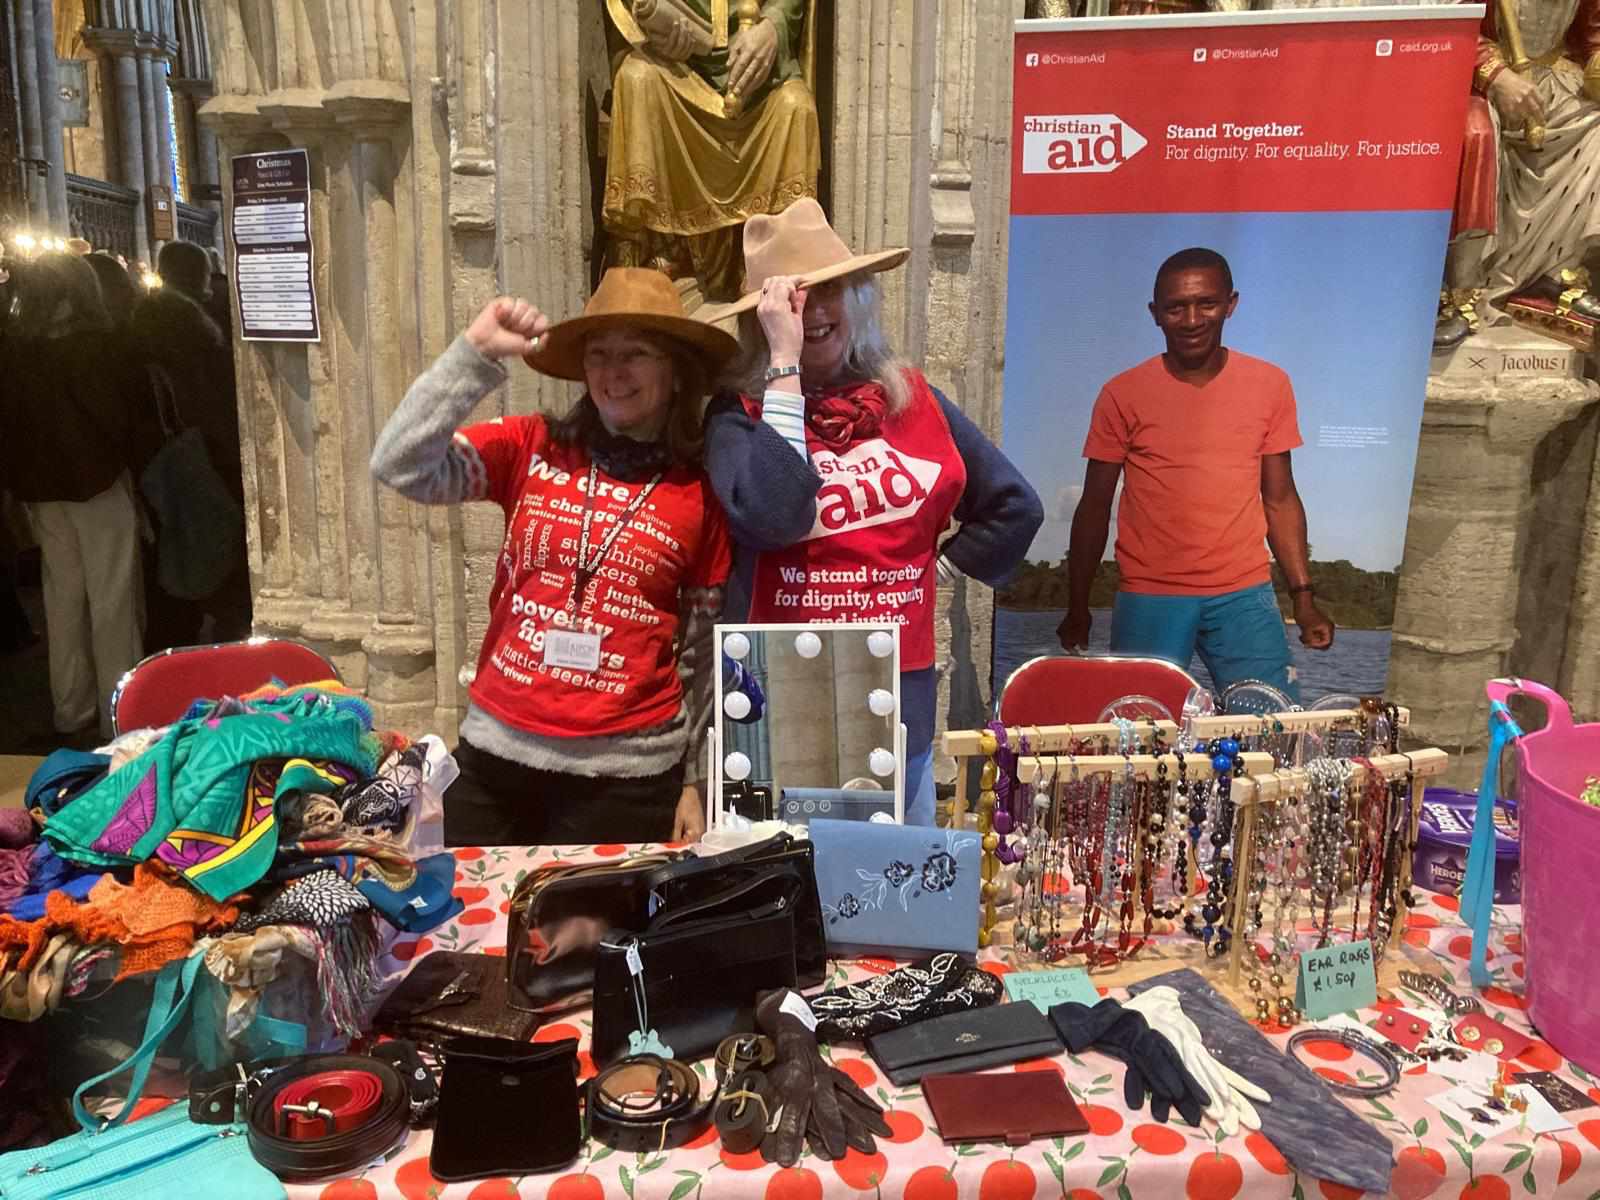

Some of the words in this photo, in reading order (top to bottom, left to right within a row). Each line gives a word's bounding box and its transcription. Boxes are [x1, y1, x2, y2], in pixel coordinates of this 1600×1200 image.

[1212, 48, 1279, 60] @ChristianAid
[1400, 41, 1452, 54] caid.org.uk
[1042, 53, 1105, 65] @ChristianAid
[1024, 119, 1102, 134] christian
[1166, 124, 1217, 139] Stand
[1222, 122, 1304, 141] Together.
[1047, 123, 1127, 170] aid
[1164, 144, 1188, 160] For
[1193, 144, 1249, 162] dignity.
[1254, 143, 1279, 158] For
[1283, 142, 1350, 161] equality.
[1357, 141, 1381, 156] For
[1385, 140, 1442, 159] justice.
[1501, 354, 1557, 371] Jacobus
[528, 453, 571, 486] We
[816, 451, 927, 529] aid
[558, 553, 638, 588] wkers
[780, 566, 806, 584] We
[810, 566, 868, 583] stand
[774, 589, 799, 607] for
[802, 588, 874, 611] dignity,
[602, 602, 660, 625] seekers
[517, 618, 626, 669] figrs
[500, 641, 548, 674] justice
[549, 667, 626, 695] seekers
[1430, 863, 1466, 881] HEROE
[1308, 956, 1334, 972] EAR
